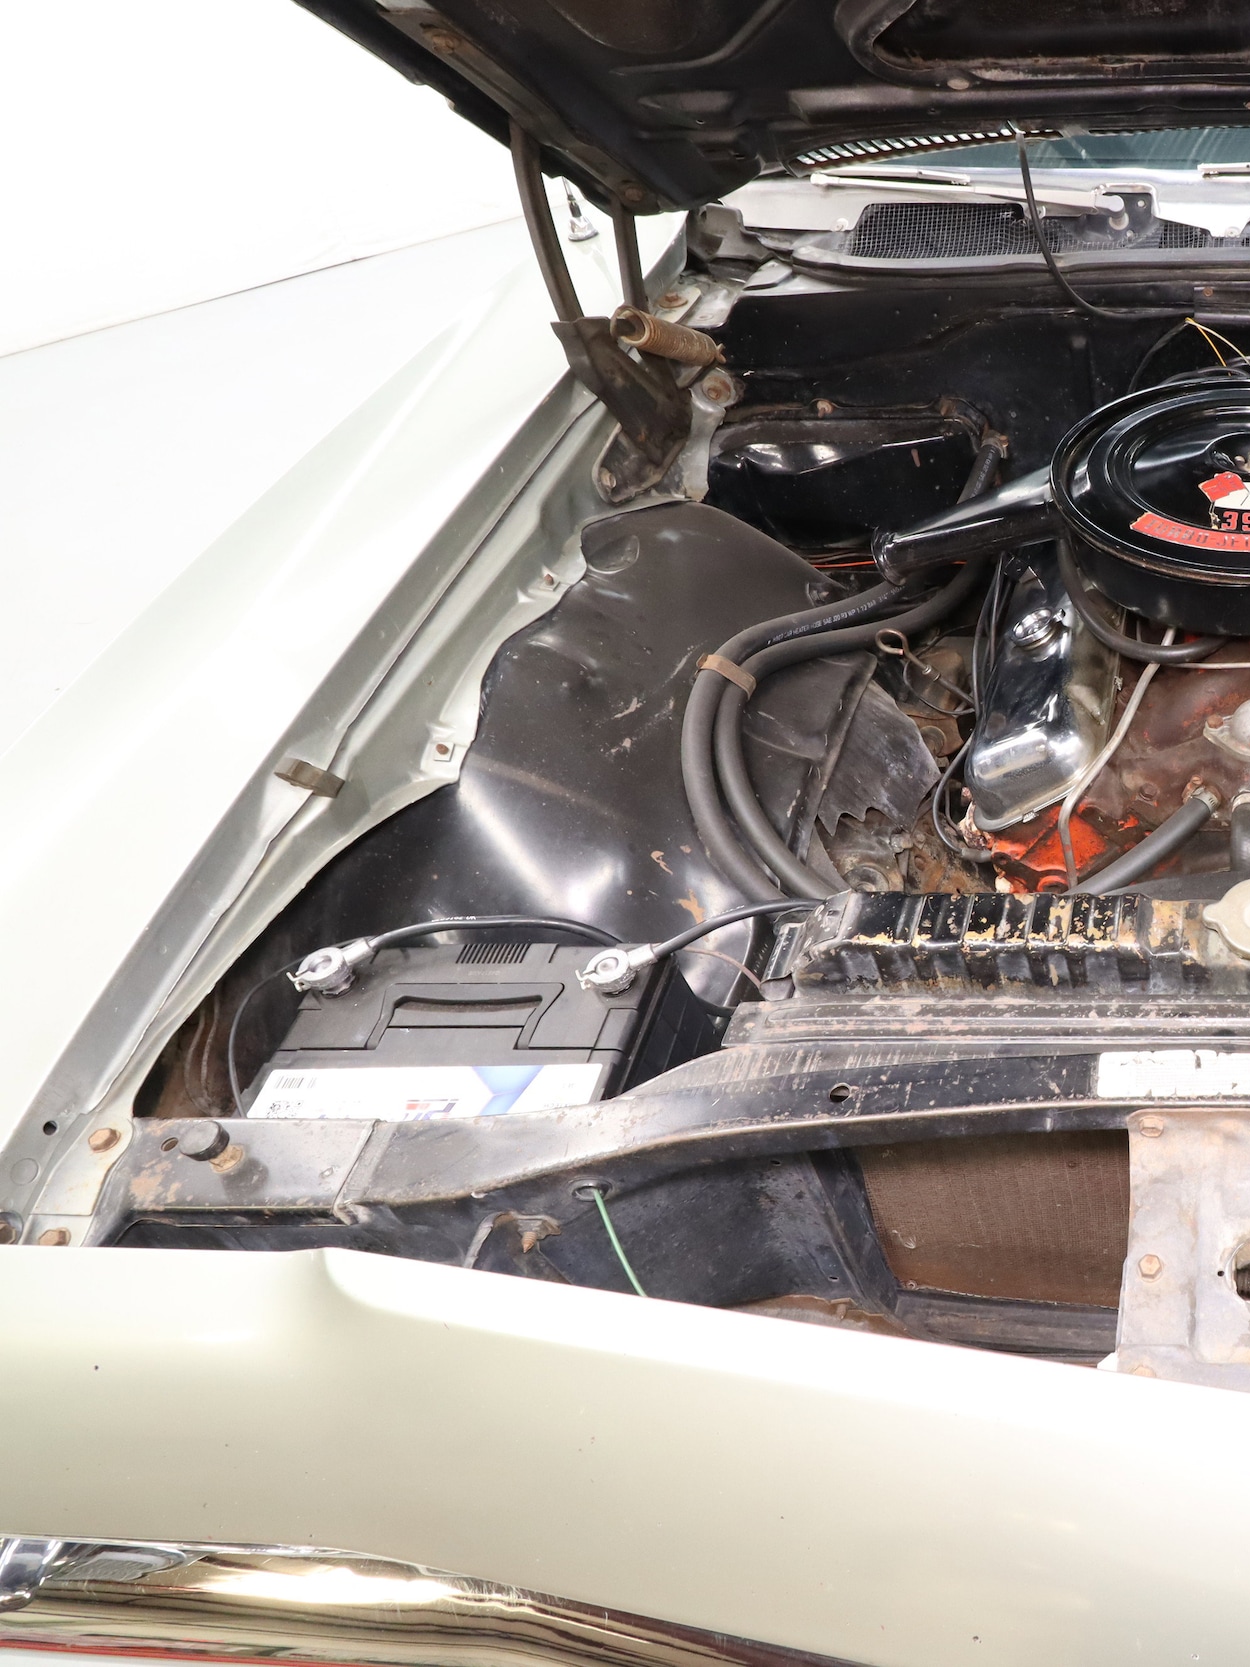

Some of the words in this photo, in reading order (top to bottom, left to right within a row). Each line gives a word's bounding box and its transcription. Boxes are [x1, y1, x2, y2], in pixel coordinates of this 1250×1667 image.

[793, 624, 810, 636] HEATER
[810, 620, 823, 629] HOSE
[823, 617, 833, 626] SAE
